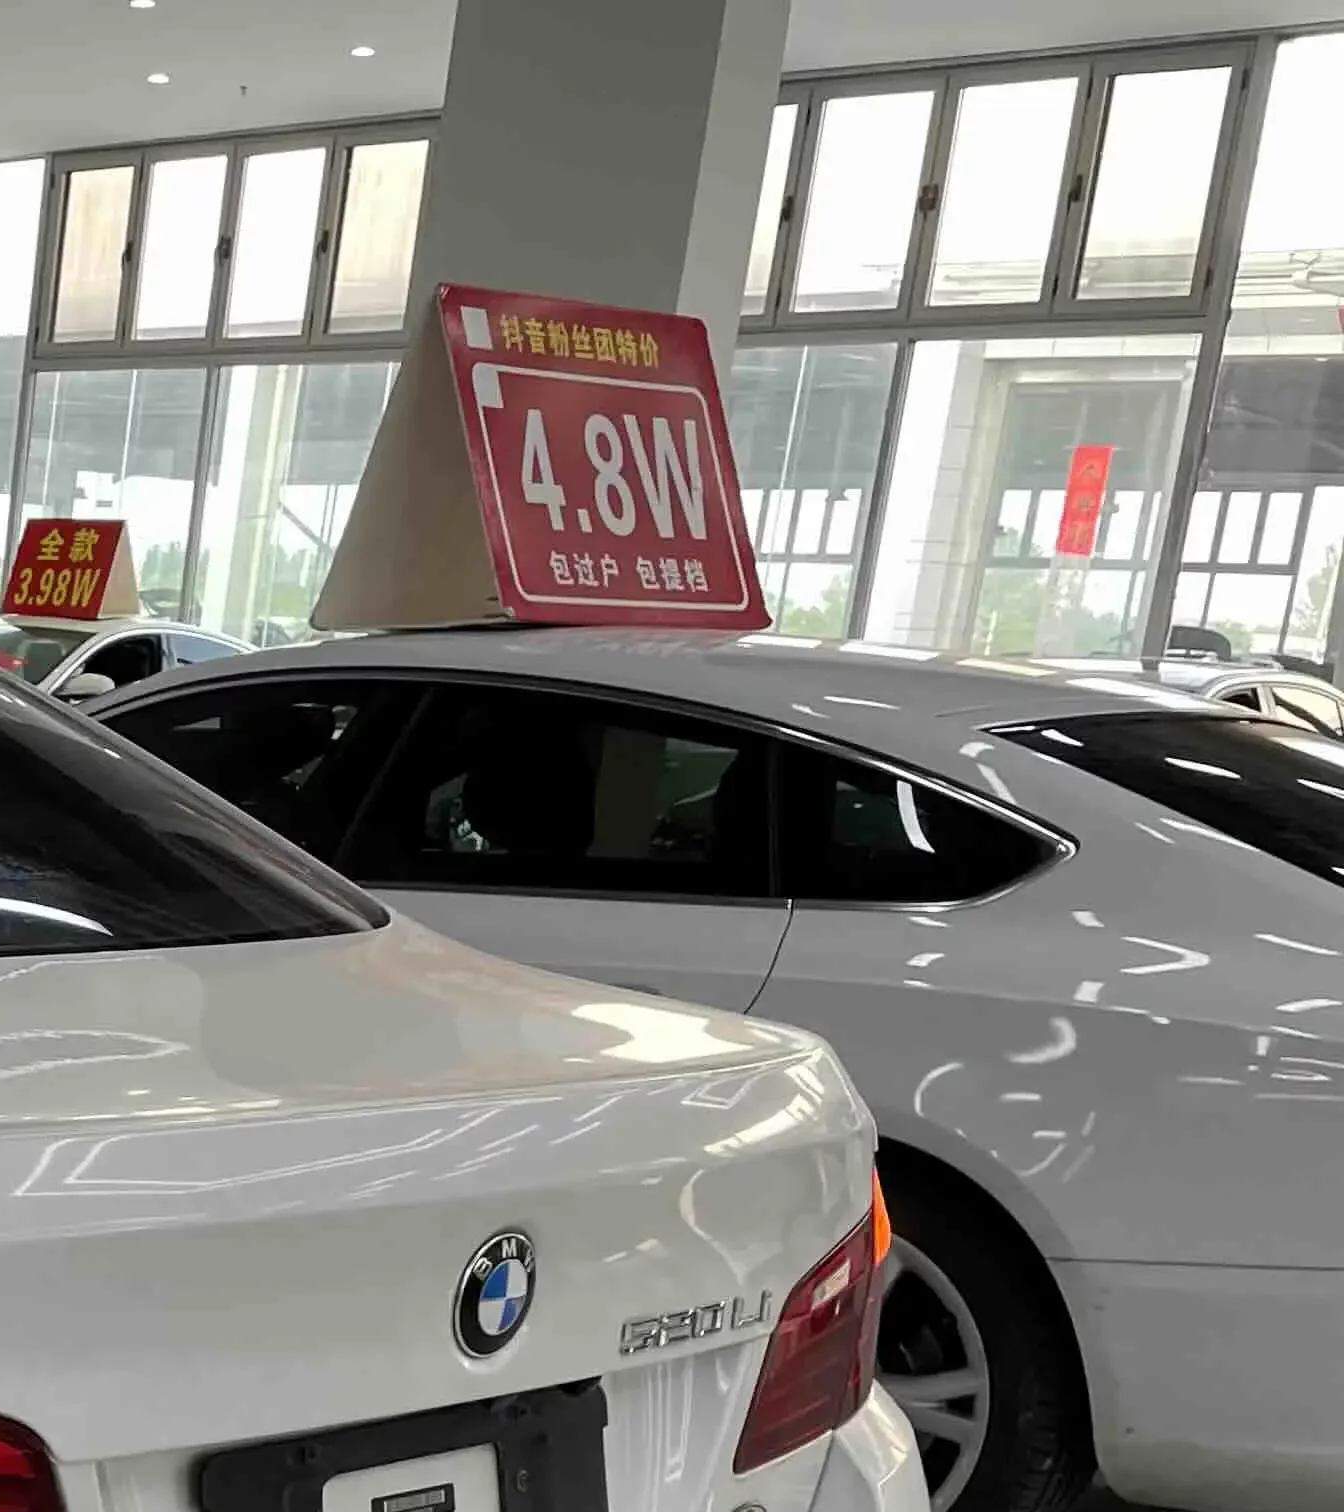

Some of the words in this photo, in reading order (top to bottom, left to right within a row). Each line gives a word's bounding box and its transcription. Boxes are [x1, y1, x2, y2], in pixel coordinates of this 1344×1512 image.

[500, 315, 658, 367] 抖音粉丝团特价
[521, 409, 707, 540] 4.8W
[37, 528, 100, 561] 全款
[14, 568, 101, 607] 3.98W
[549, 551, 618, 587] 包过户
